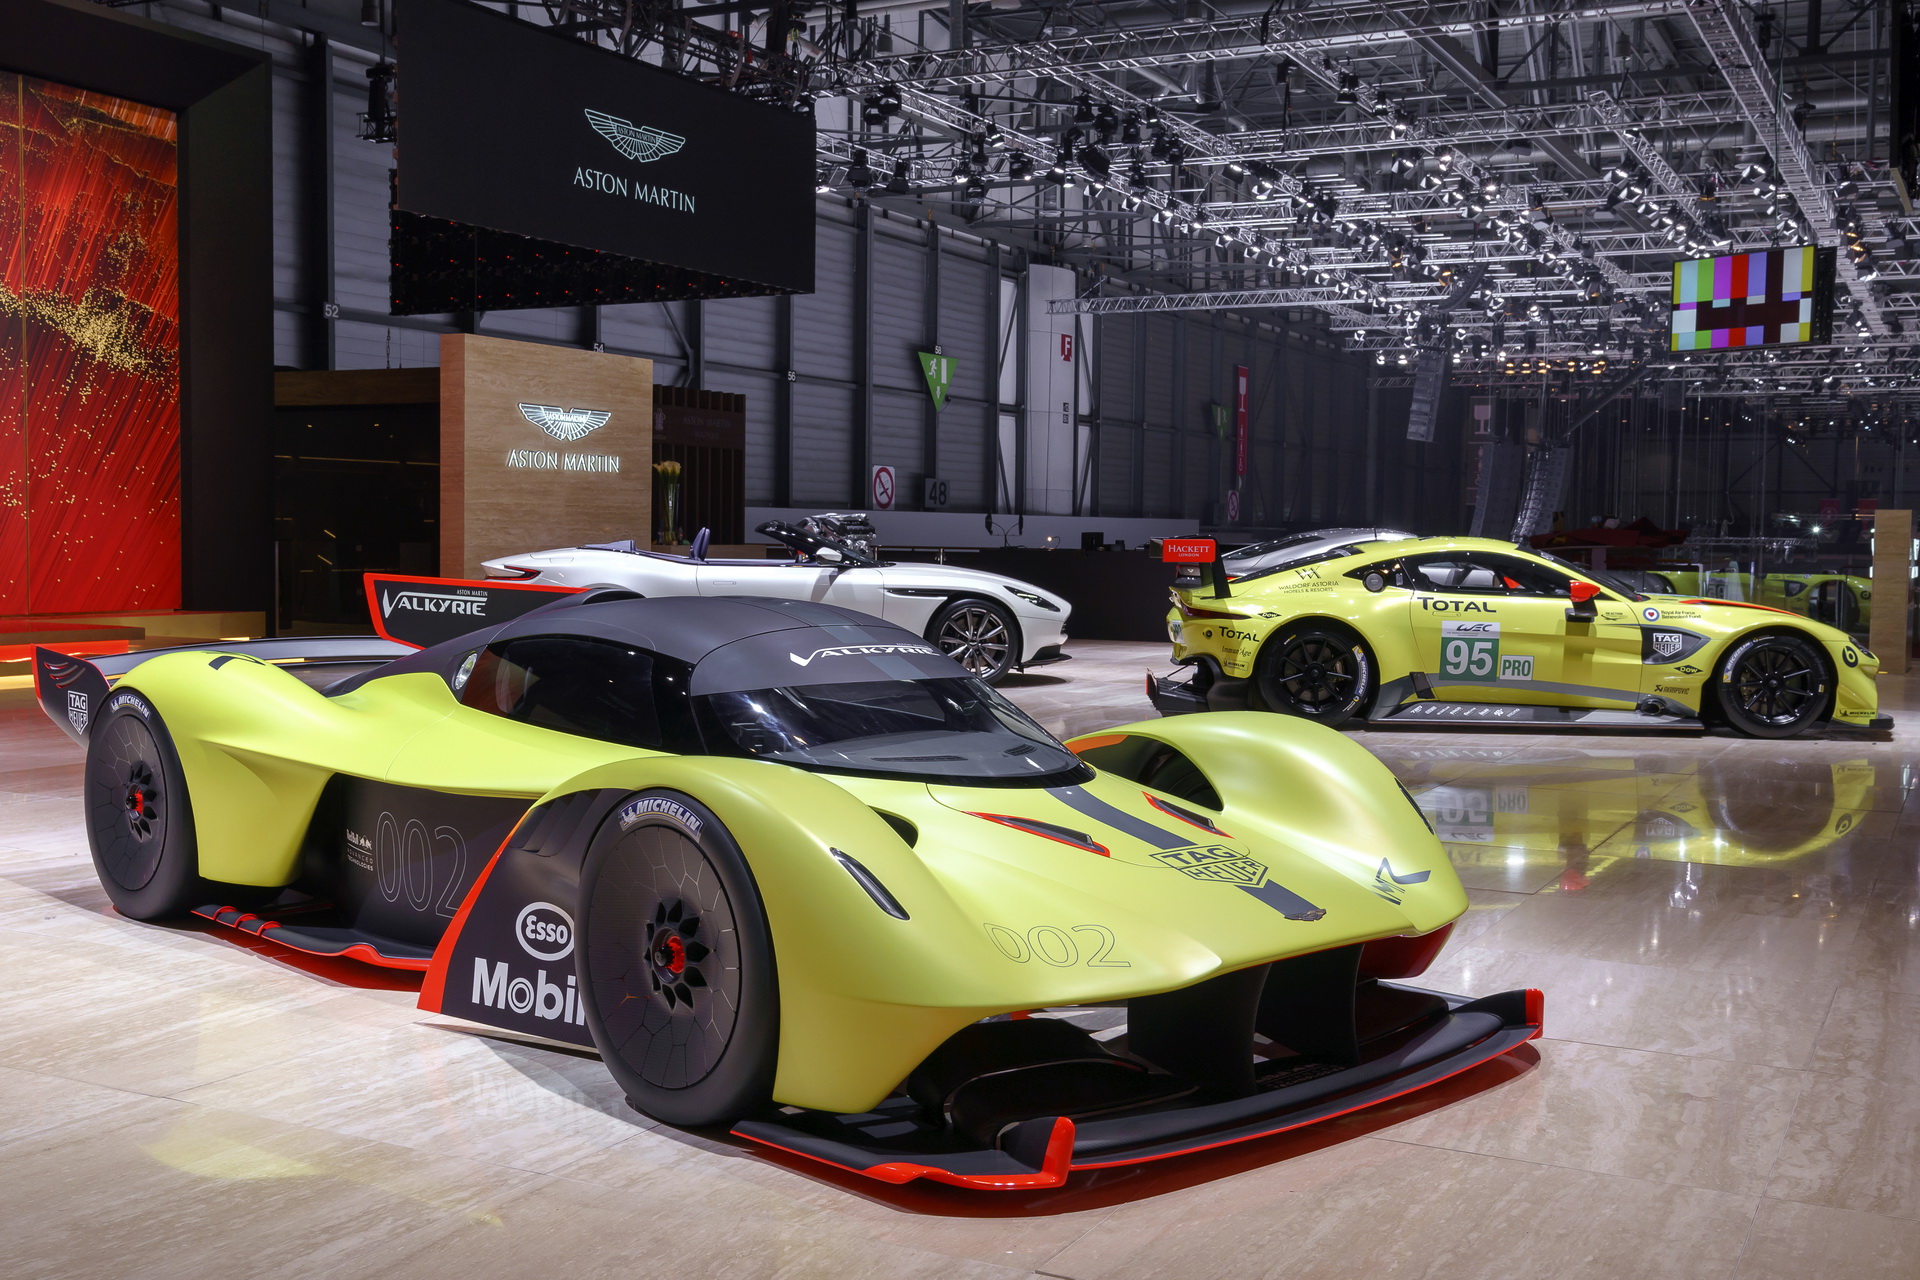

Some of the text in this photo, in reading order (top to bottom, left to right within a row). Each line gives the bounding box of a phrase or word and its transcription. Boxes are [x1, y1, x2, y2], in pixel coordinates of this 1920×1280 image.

[573, 166, 695, 213] ASTON MARTIN
[325, 303, 339, 318] 52
[1064, 336, 1071, 355] F
[787, 371, 796, 381] 56
[506, 448, 620, 473] ASTON MARTIN
[929, 480, 947, 506] 48
[1168, 544, 1210, 553] HACKETT
[1278, 580, 1340, 591] WALDORF ASTORIA
[382, 588, 488, 619] VALKYRIE
[1417, 596, 1497, 613] TOTAL
[1218, 625, 1260, 642] TOTAL
[1456, 623, 1493, 632] WEC
[1656, 634, 1680, 642] TAG
[1445, 639, 1493, 676] 95
[1655, 643, 1680, 655] HEUER
[1501, 659, 1532, 677] PRO
[69, 693, 86, 710] TAG
[118, 695, 150, 718] MICHELIN
[636, 799, 701, 831] MICHELIN
[376, 811, 467, 919] 002
[1160, 846, 1239, 865] TAG
[1187, 859, 1262, 883] HEUER
[983, 922, 1132, 968] 002
